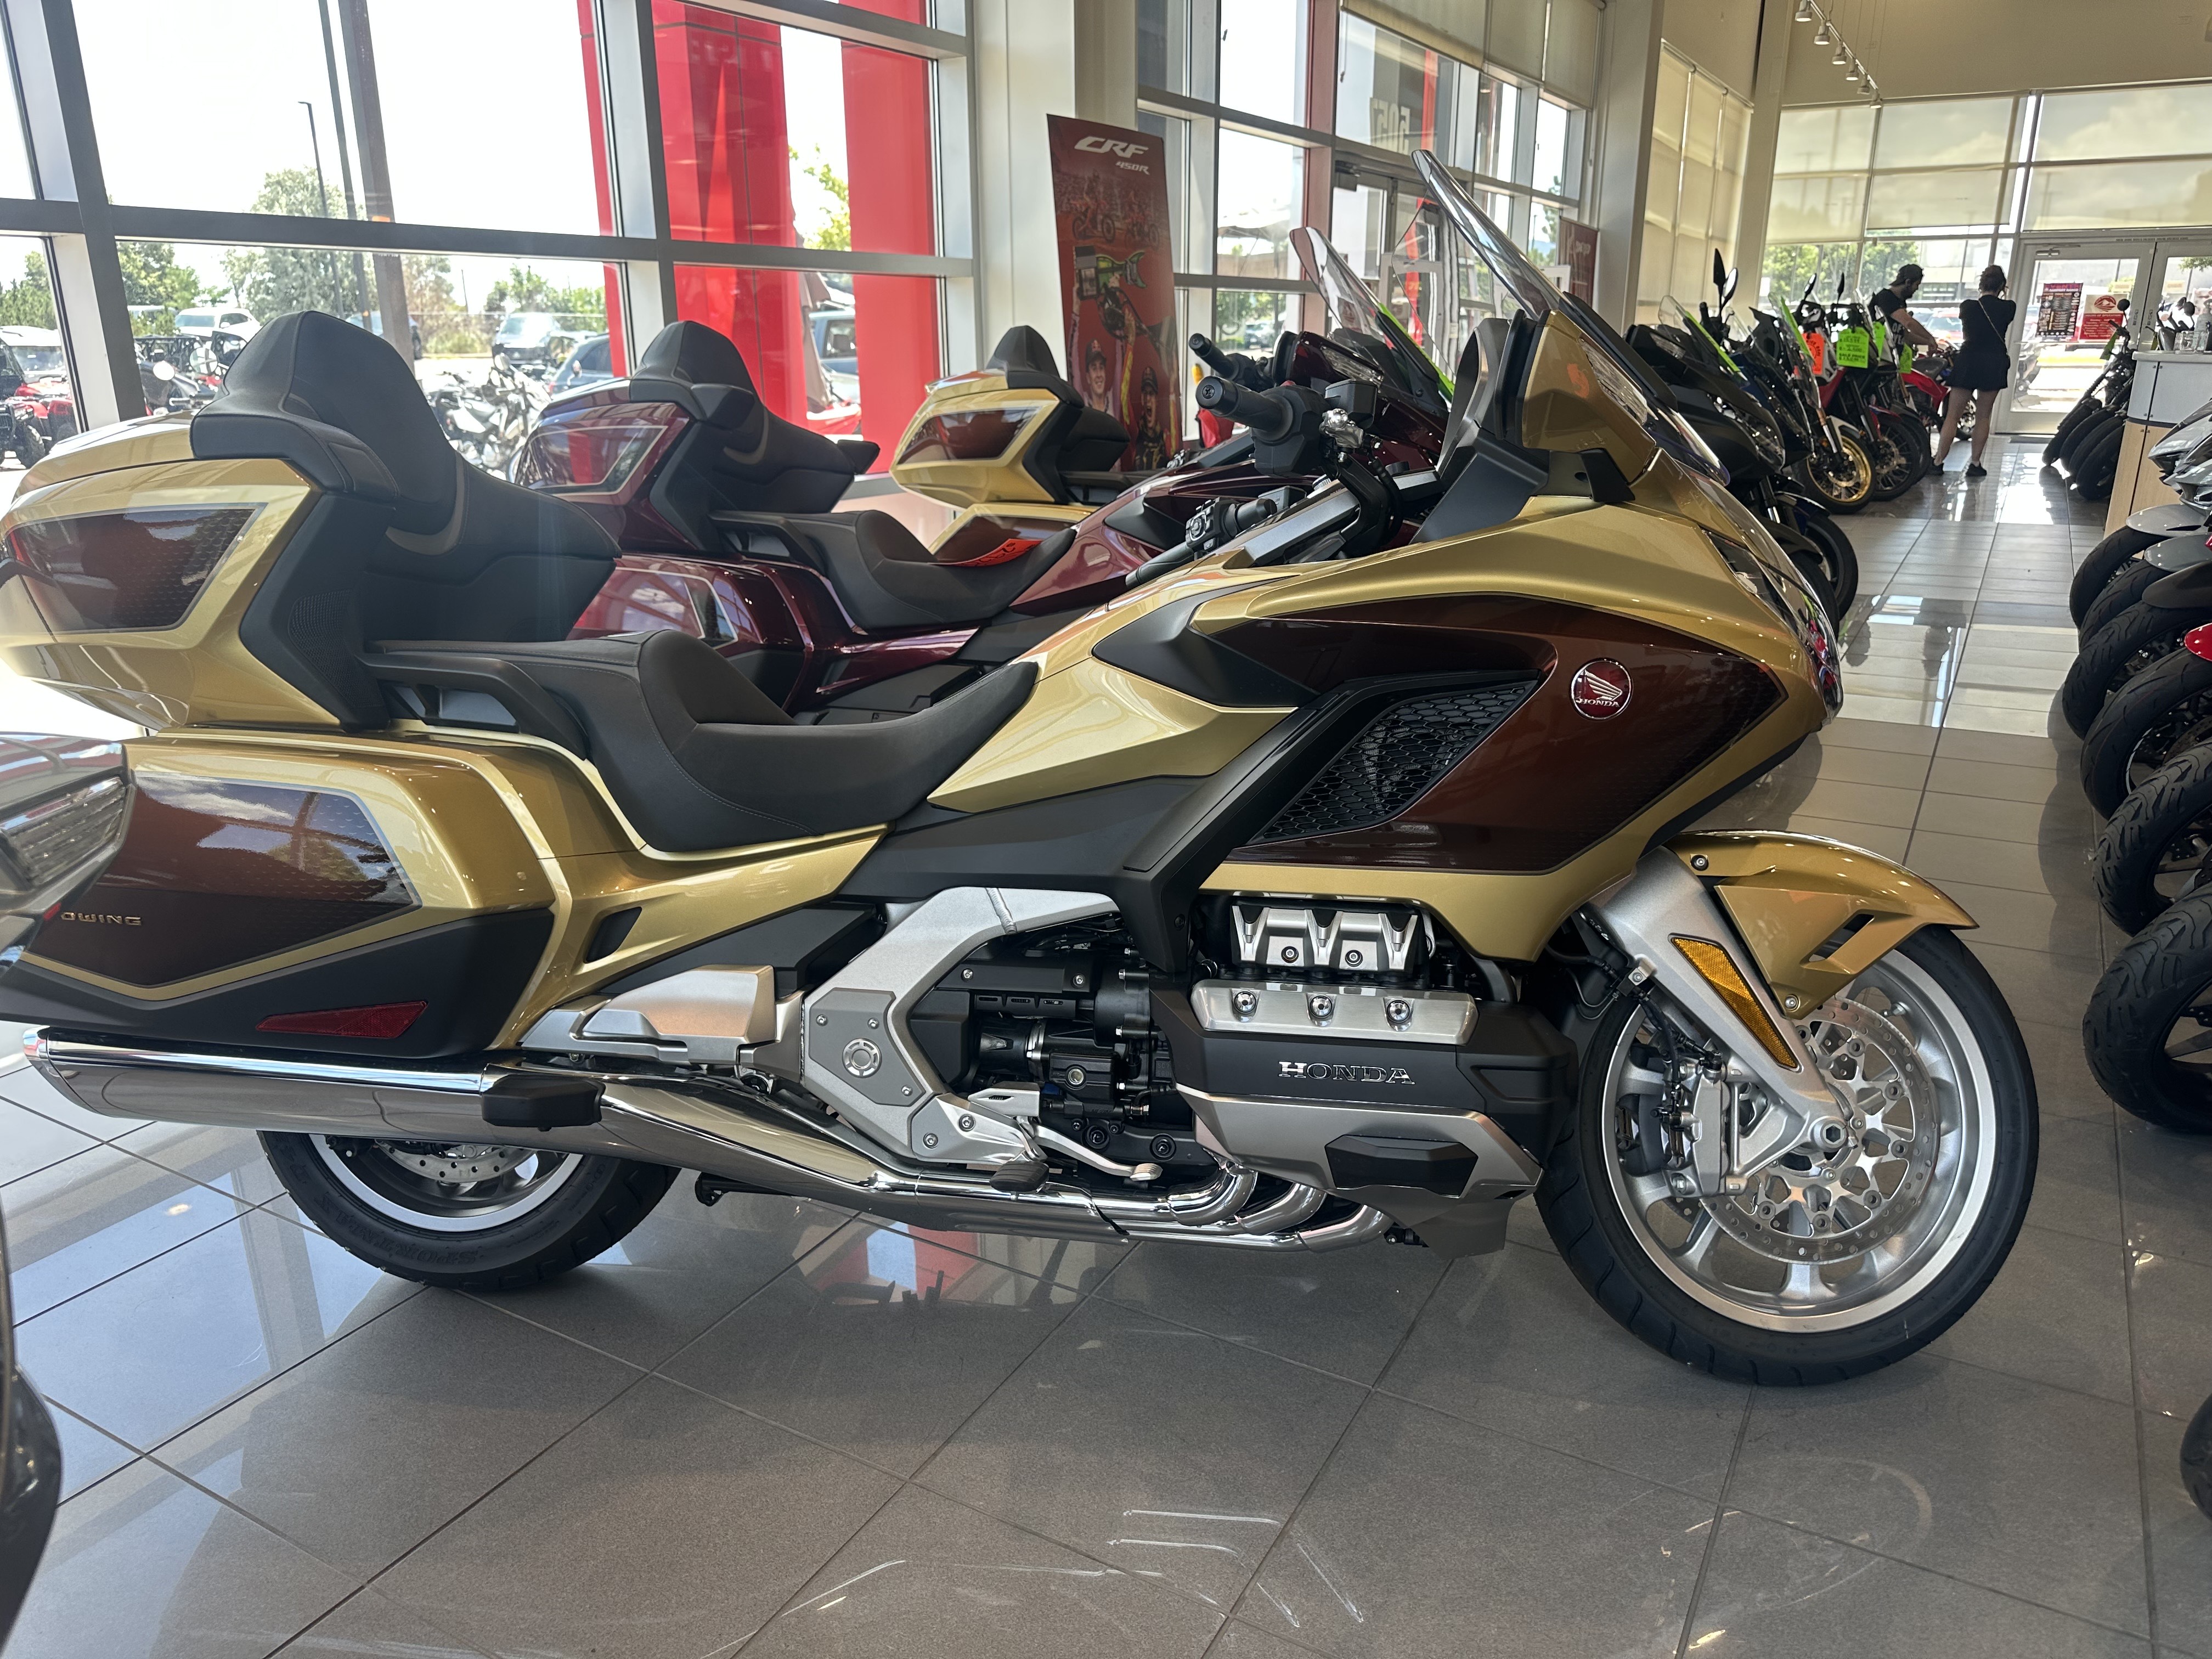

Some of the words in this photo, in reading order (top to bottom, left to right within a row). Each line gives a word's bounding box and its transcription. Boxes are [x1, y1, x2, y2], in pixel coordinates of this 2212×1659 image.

[1074, 136, 1149, 159] CRF
[1115, 161, 1150, 176] 450R
[1576, 698, 1620, 708] HONDA
[1278, 1060, 1416, 1086] HONDA
[314, 1191, 479, 1266] SPORTMAX
